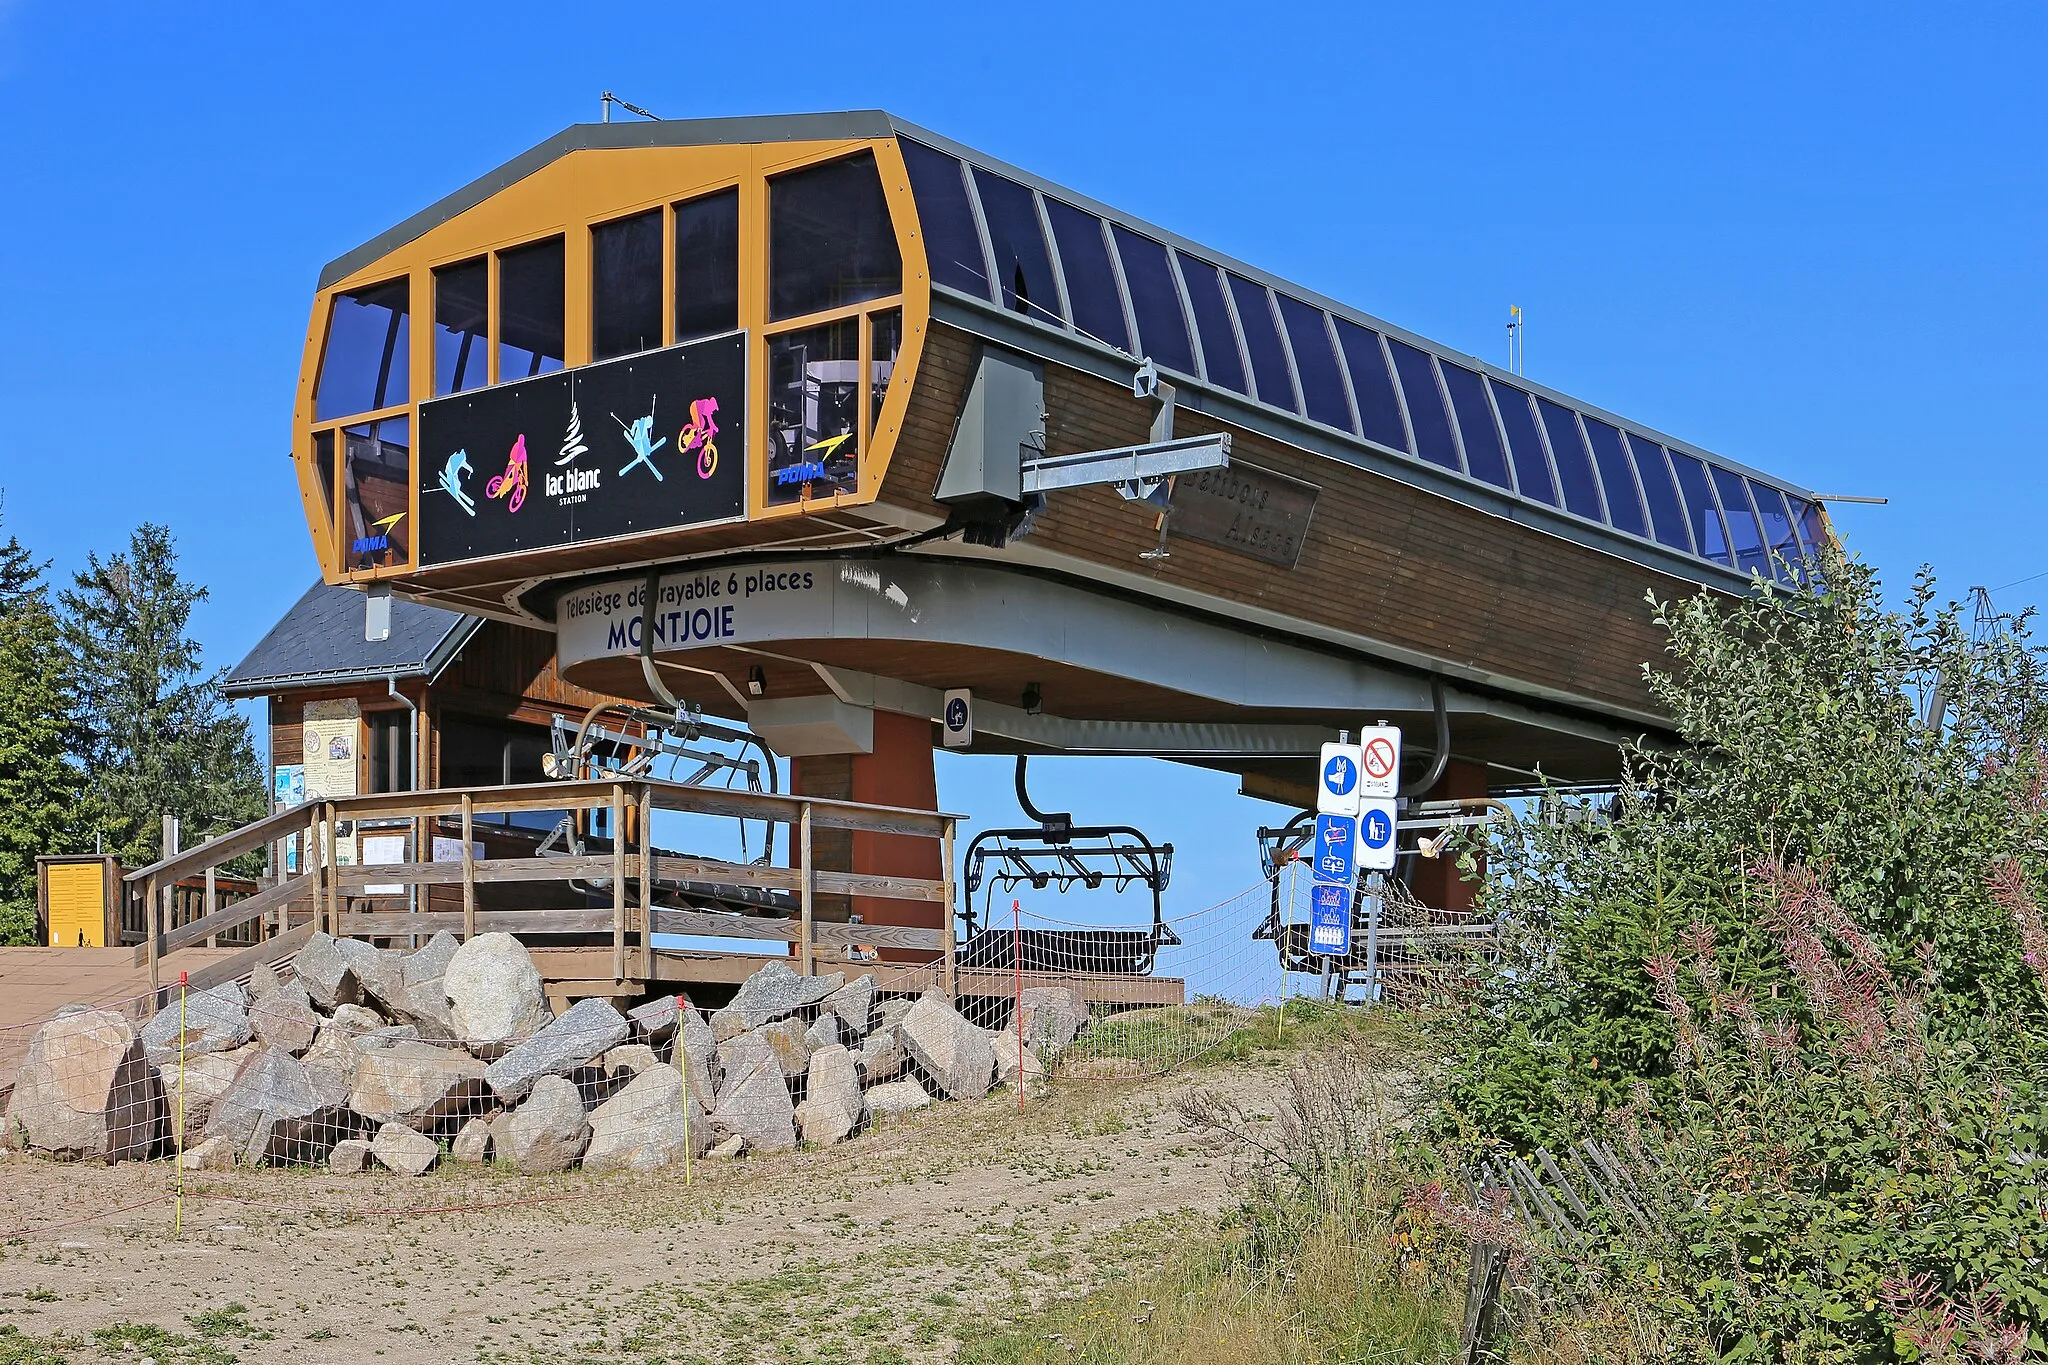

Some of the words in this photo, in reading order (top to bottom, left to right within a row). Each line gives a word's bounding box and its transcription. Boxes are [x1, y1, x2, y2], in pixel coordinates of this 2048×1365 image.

[546, 473, 564, 497] lac
[566, 467, 600, 493] blanc
[778, 461, 825, 485] POMA
[559, 494, 587, 506] STATION
[352, 535, 387, 553] POMA
[627, 574, 720, 608] dérayable
[727, 572, 738, 595] 6
[745, 570, 813, 598] places
[607, 605, 735, 650] MONTJOIE
